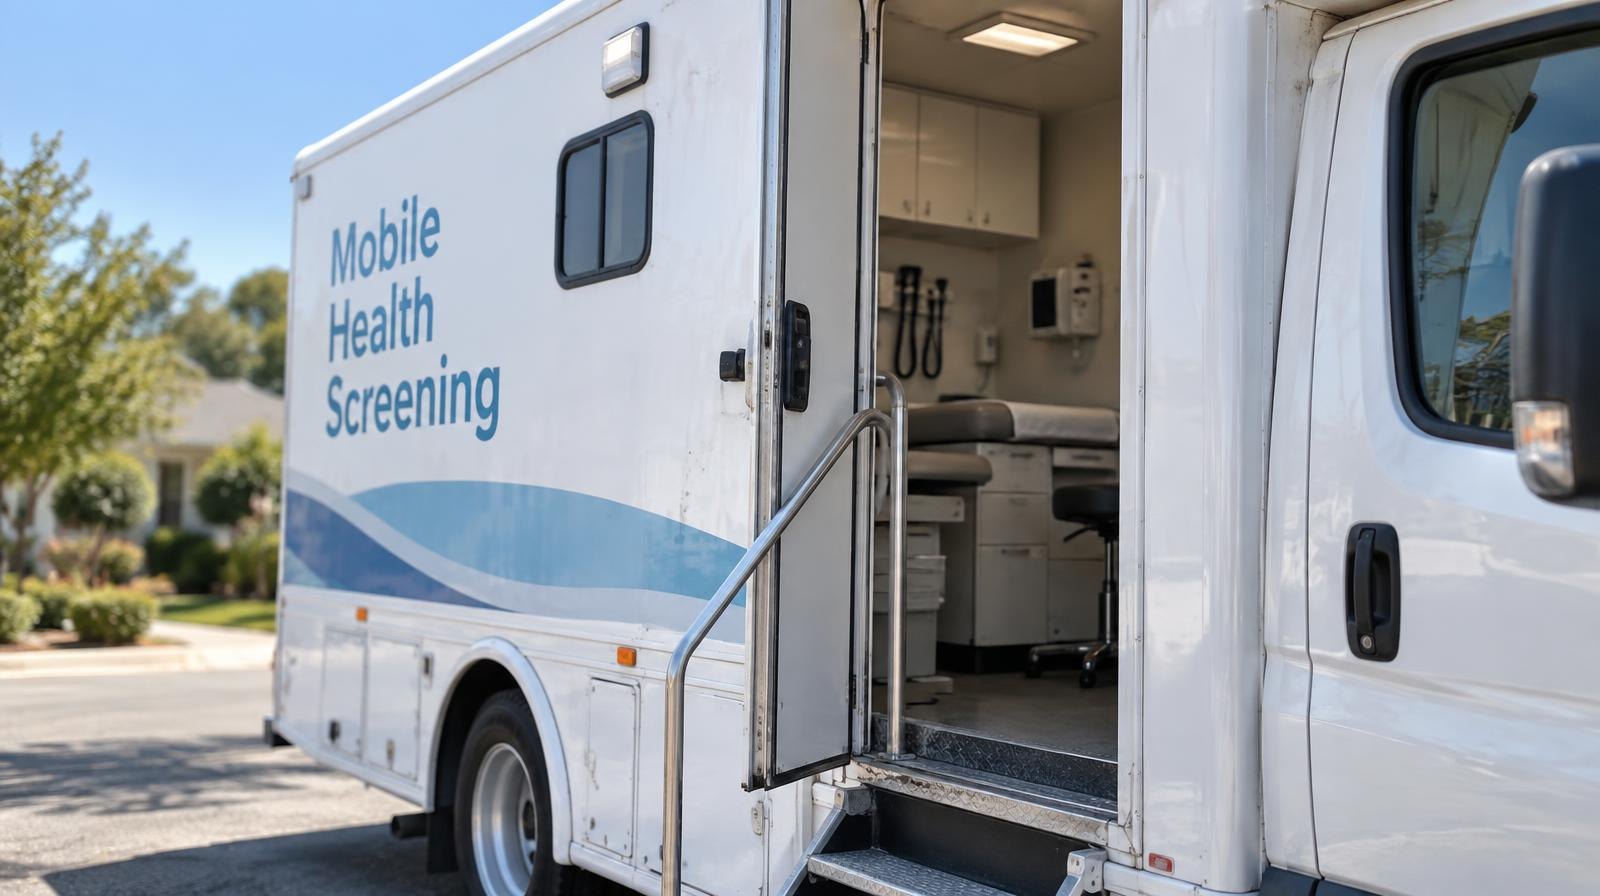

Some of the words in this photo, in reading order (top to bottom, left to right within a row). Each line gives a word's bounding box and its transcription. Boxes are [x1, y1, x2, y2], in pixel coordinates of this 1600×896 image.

[330, 194, 441, 288] Mobile
[328, 275, 434, 363] Health
[325, 354, 501, 442] Screening
